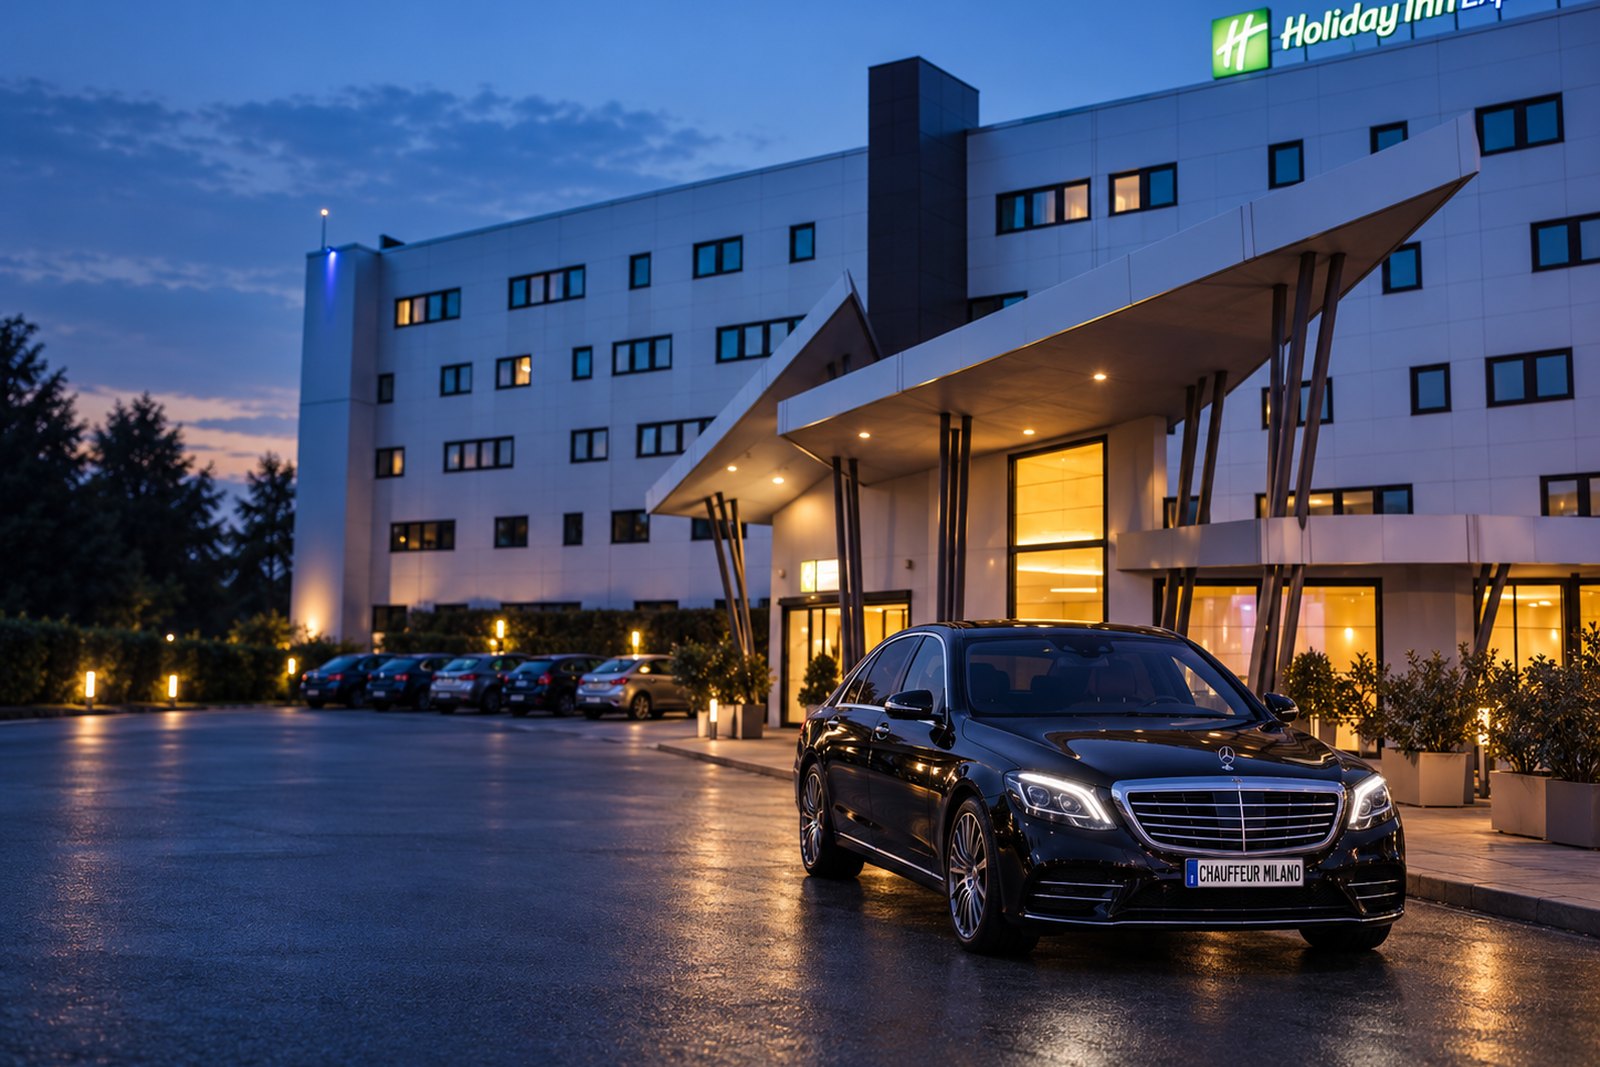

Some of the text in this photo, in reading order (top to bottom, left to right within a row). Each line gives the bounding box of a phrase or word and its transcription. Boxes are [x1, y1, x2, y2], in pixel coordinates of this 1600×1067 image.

[1280, 2, 1399, 50] Holiday
[1199, 865, 1301, 882] CHAUFFEUR MILANO
